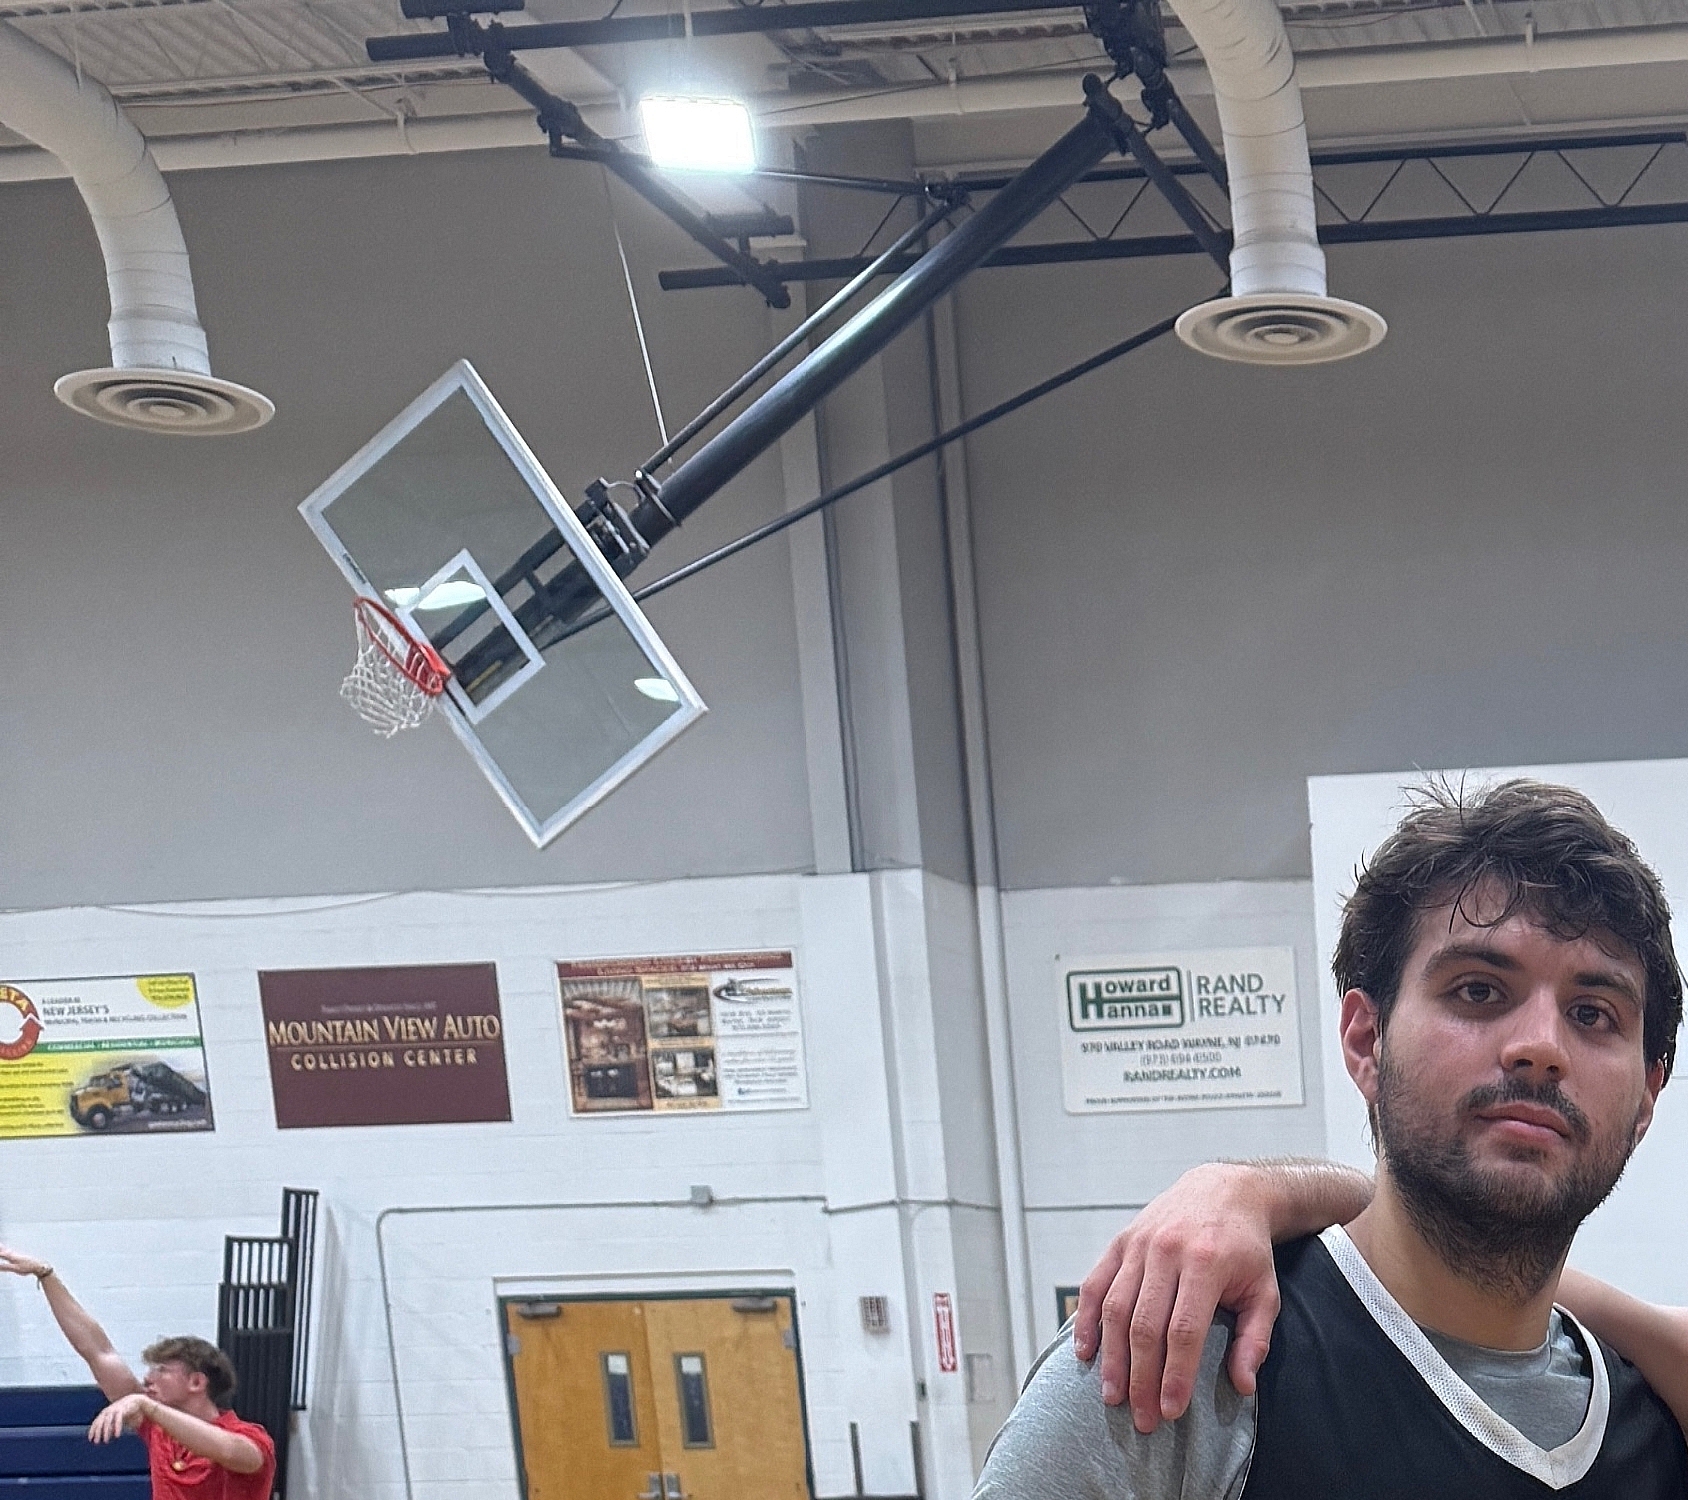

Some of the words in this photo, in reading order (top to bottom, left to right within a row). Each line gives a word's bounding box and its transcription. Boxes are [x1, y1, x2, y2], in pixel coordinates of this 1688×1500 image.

[1079, 974, 1171, 1002] Howard
[1197, 973, 1264, 995] RAND
[43, 1006, 65, 1016] NEW
[67, 1004, 110, 1016] JERSEY'S
[1079, 997, 1160, 1019] Hanna
[1199, 994, 1286, 1017] REALTY
[268, 1018, 379, 1046] MOUNTAIN
[382, 1014, 438, 1041] VIEW
[443, 1013, 501, 1040] AUTO
[1147, 1040, 1180, 1051] ROAD
[290, 1051, 395, 1071] COLLISION
[403, 1048, 477, 1067] CENTER
